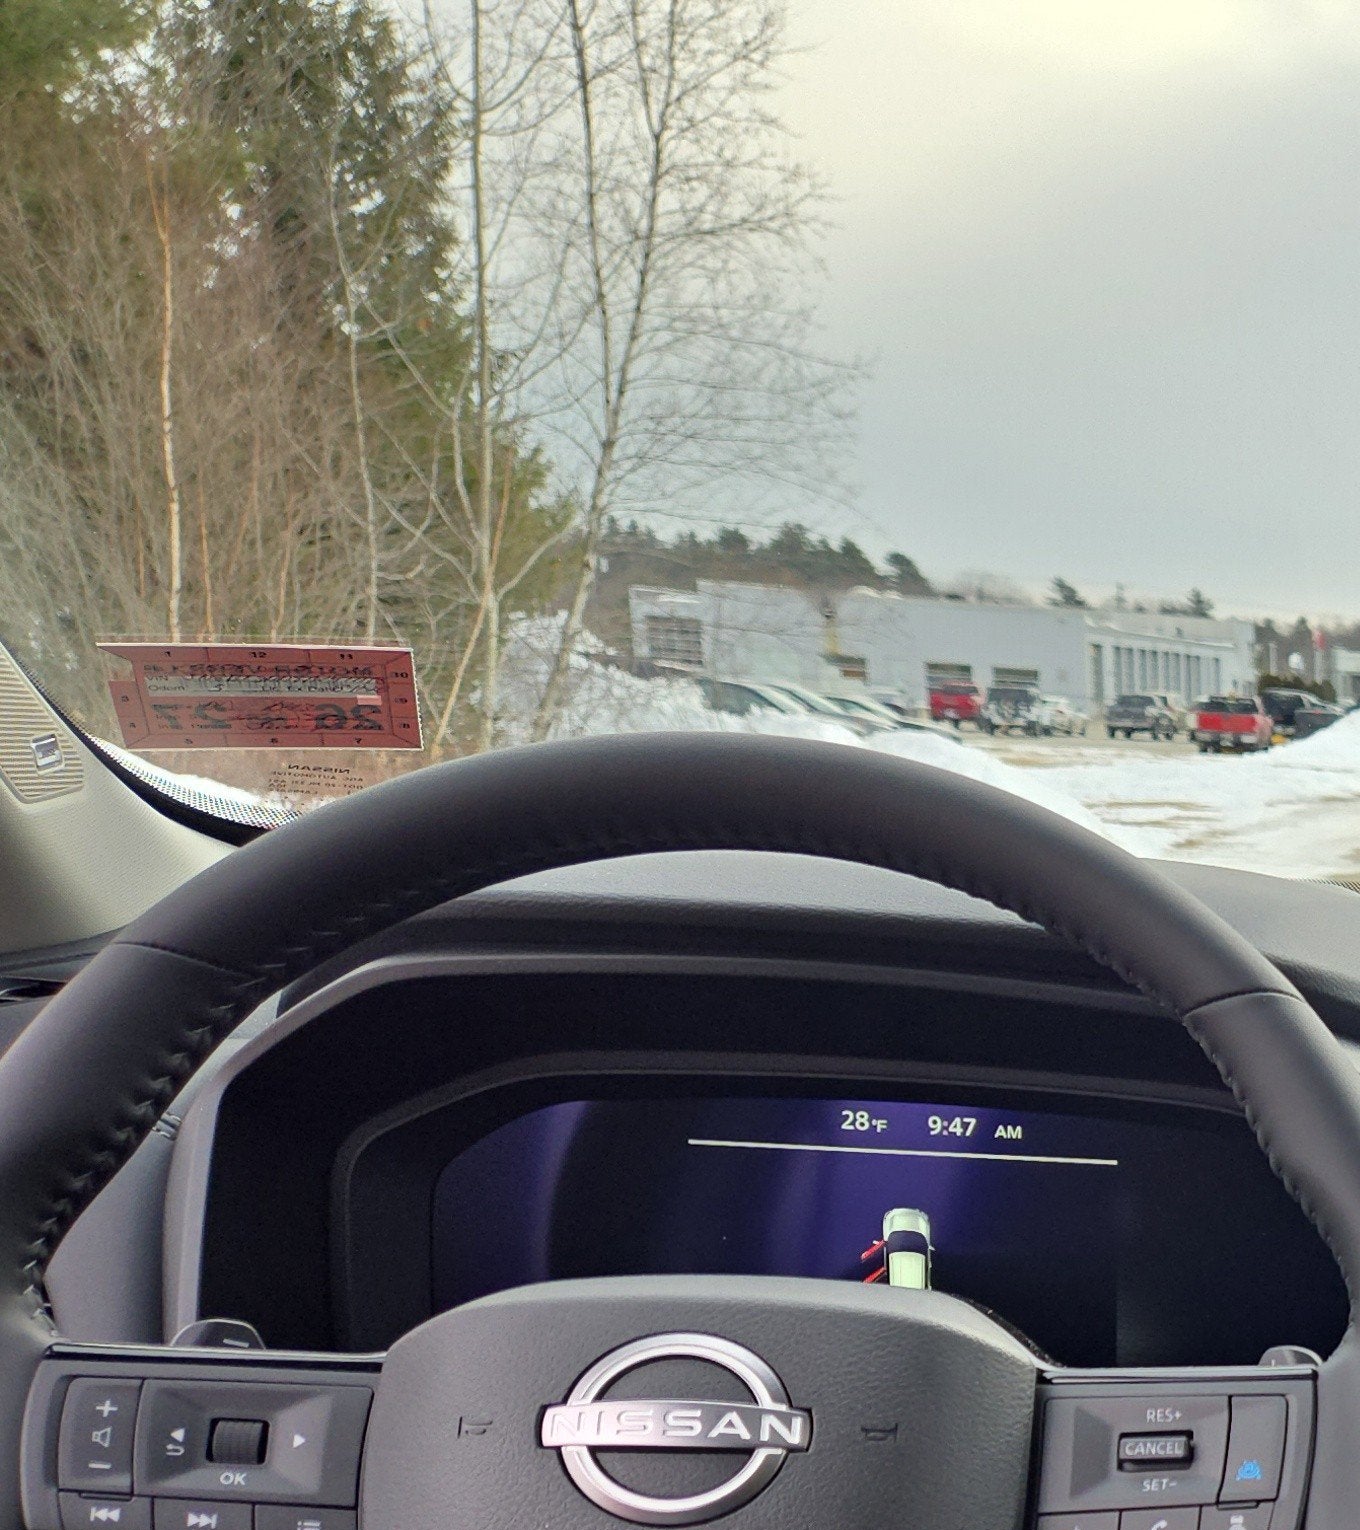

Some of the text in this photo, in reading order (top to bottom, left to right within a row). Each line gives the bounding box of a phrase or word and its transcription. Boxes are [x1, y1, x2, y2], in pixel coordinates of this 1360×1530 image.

[927, 1115, 1022, 1140] 9:47 AM
[1146, 1407, 1182, 1423] RES+
[550, 1409, 804, 1445] NISSAN
[1125, 1441, 1184, 1456] CANCEL
[220, 1471, 246, 1485] OK
